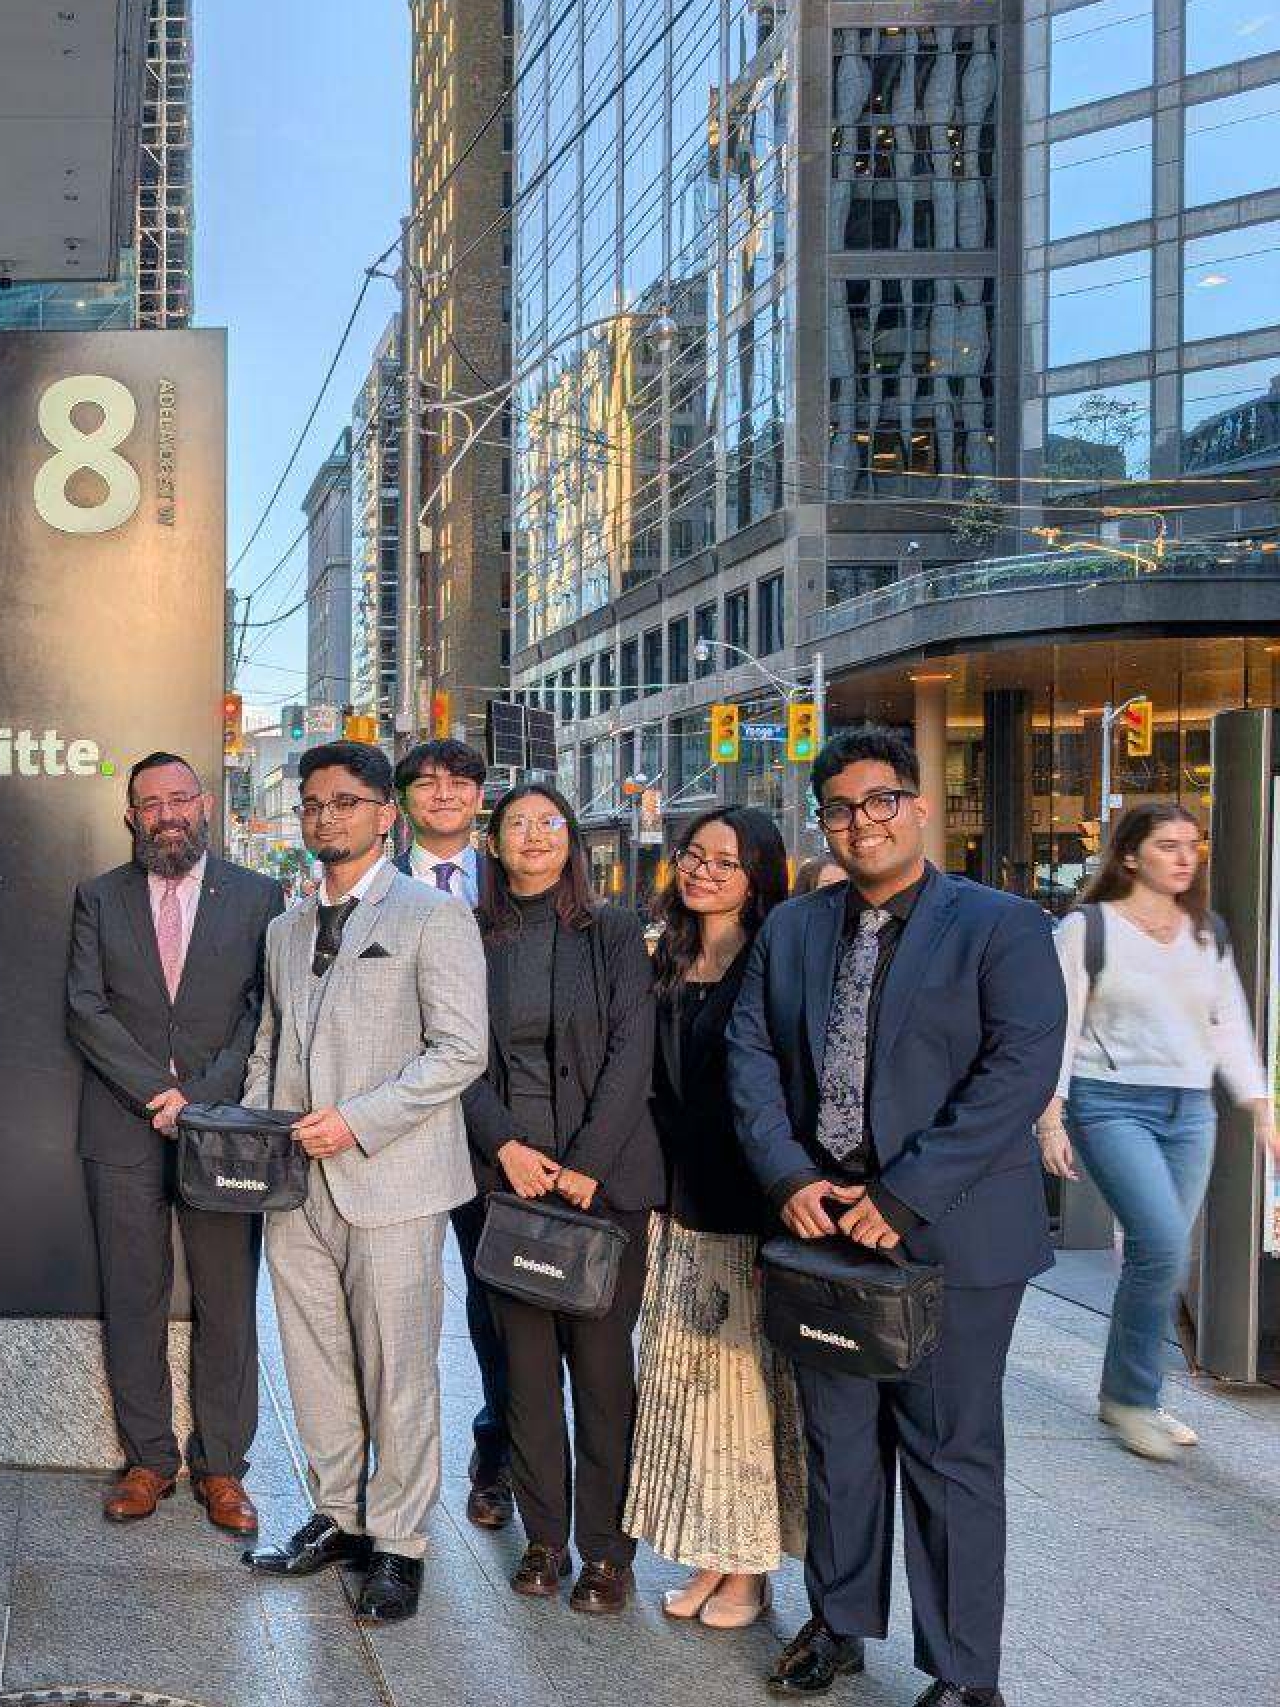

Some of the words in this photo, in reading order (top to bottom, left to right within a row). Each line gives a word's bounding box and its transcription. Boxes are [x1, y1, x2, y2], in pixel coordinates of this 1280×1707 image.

[34, 374, 141, 533] 8
[159, 379, 177, 475] ADELAIDE
[157, 507, 177, 527] W
